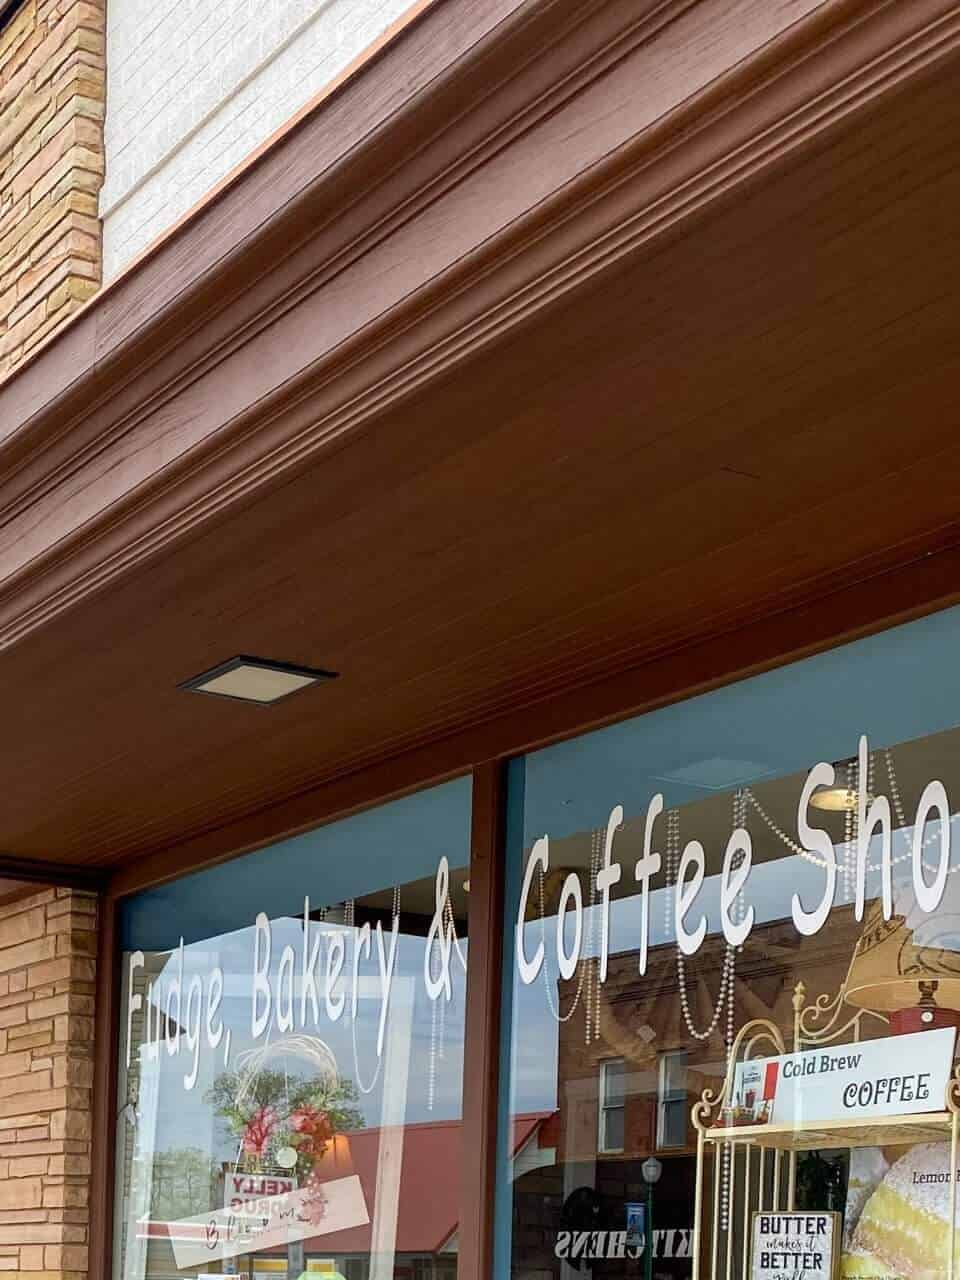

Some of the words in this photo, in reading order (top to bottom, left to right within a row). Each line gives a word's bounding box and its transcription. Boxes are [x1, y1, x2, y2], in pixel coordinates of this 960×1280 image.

[126, 936, 231, 1089] Fudge,
[252, 895, 399, 1056] Bakery
[424, 856, 473, 1000] &
[516, 793, 754, 984] Coffee
[791, 735, 951, 936] Sho
[783, 1056, 817, 1078] Cold
[820, 1054, 862, 1074] Brew
[843, 1073, 931, 1108] COFFEE
[760, 1216, 827, 1235] BUTTER
[766, 1238, 802, 1250] makes
[804, 1236, 816, 1249] it
[760, 1252, 823, 1270] BETTER
